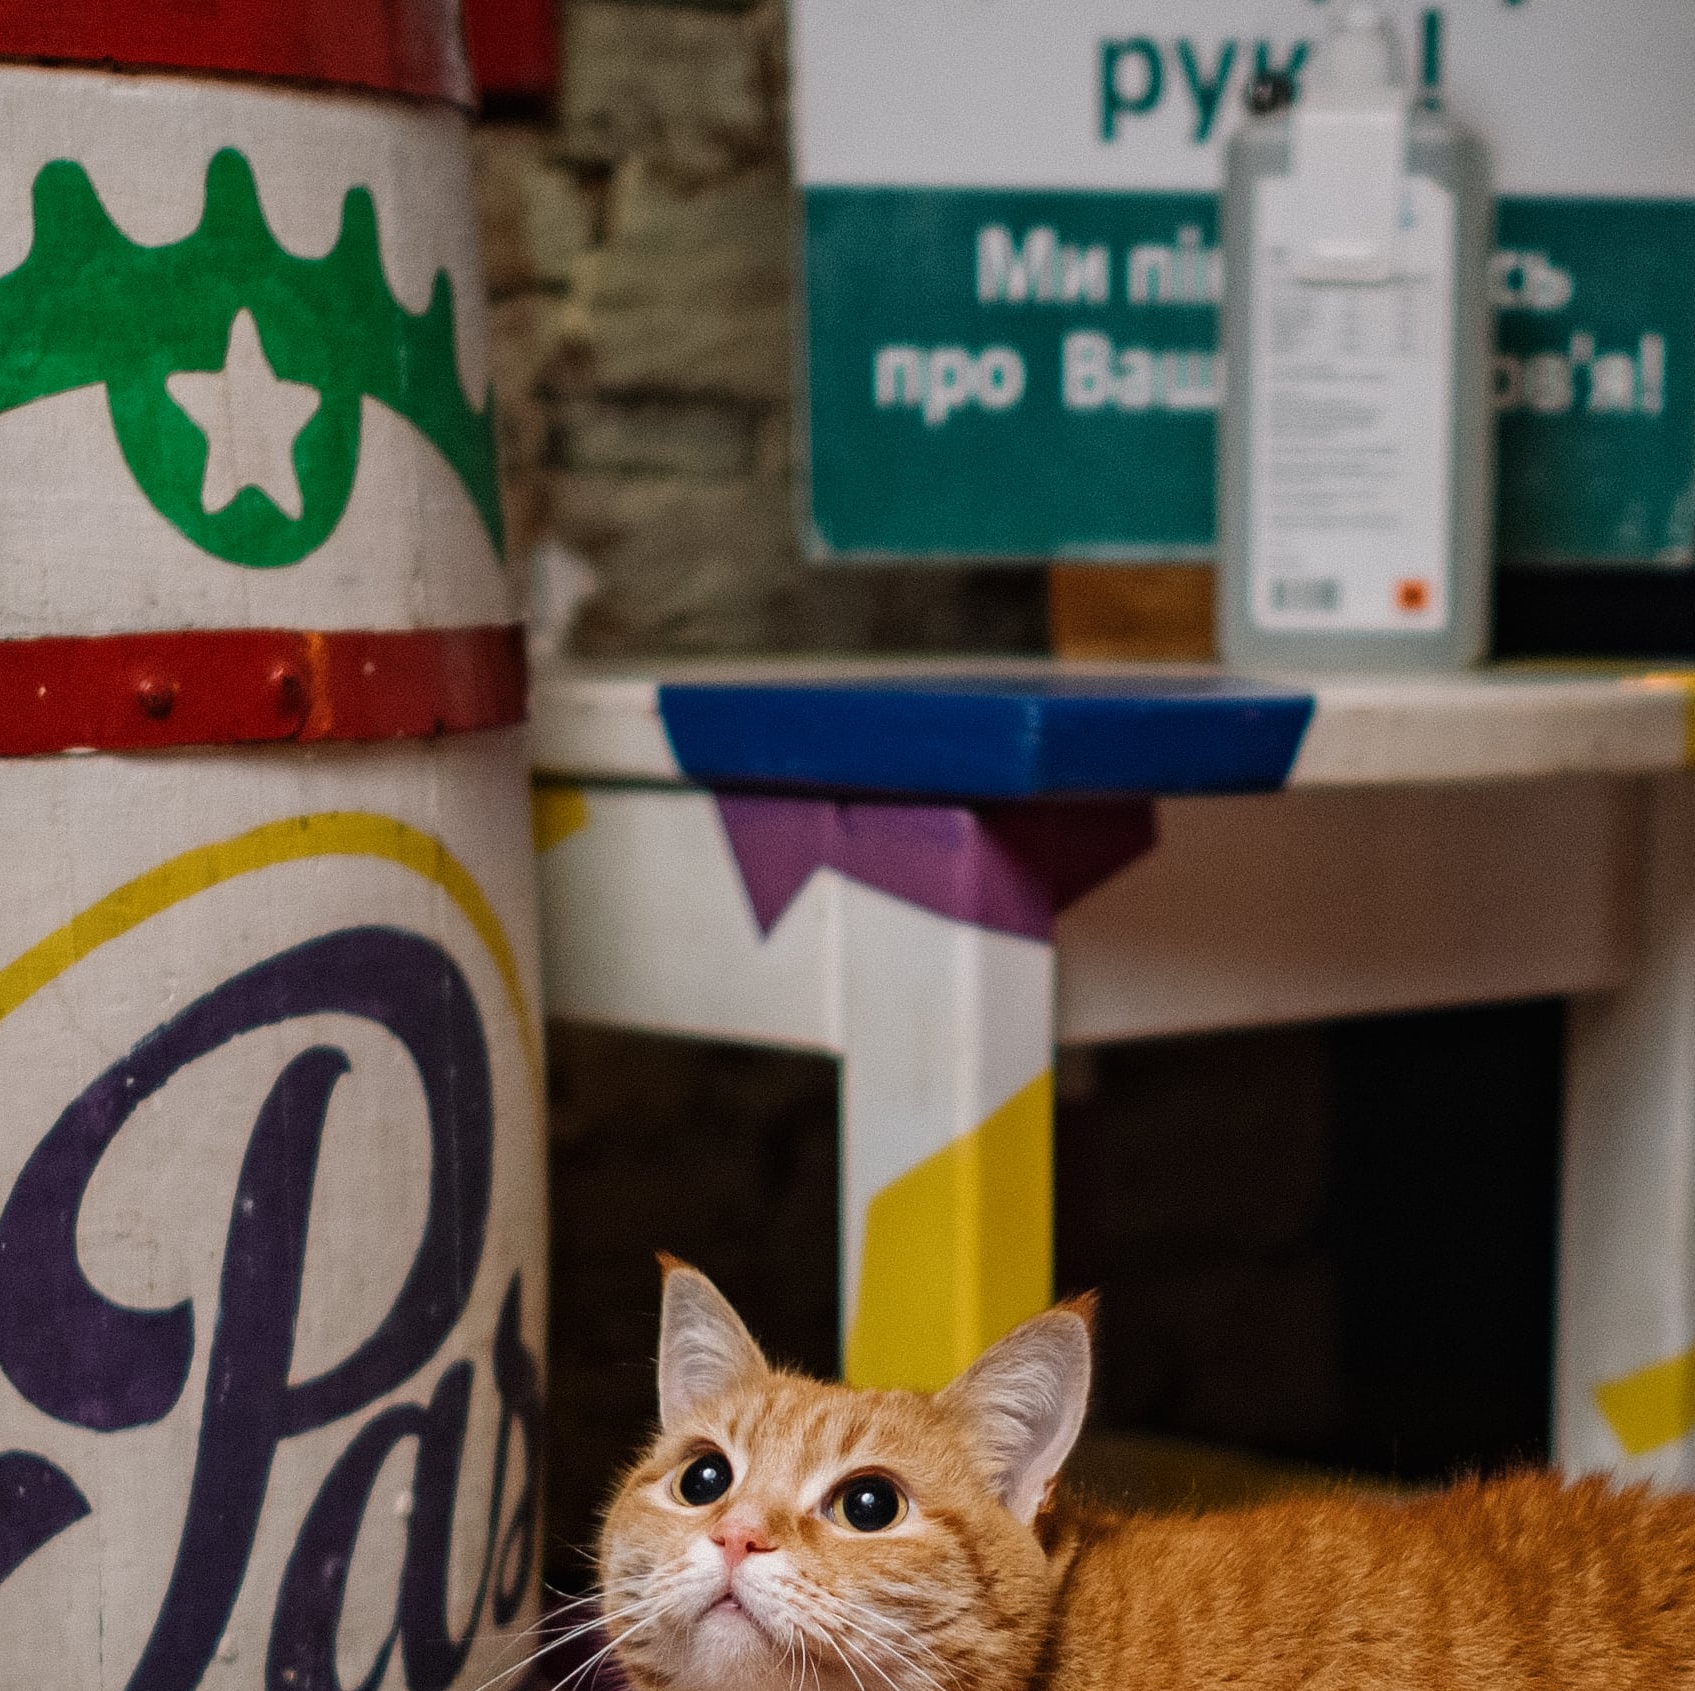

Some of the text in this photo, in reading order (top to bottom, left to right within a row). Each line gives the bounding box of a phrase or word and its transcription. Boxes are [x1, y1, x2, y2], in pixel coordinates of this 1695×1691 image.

[1099, 8, 1443, 144] рук!
[976, 224, 1110, 304] Ми
[874, 344, 1026, 429] про
